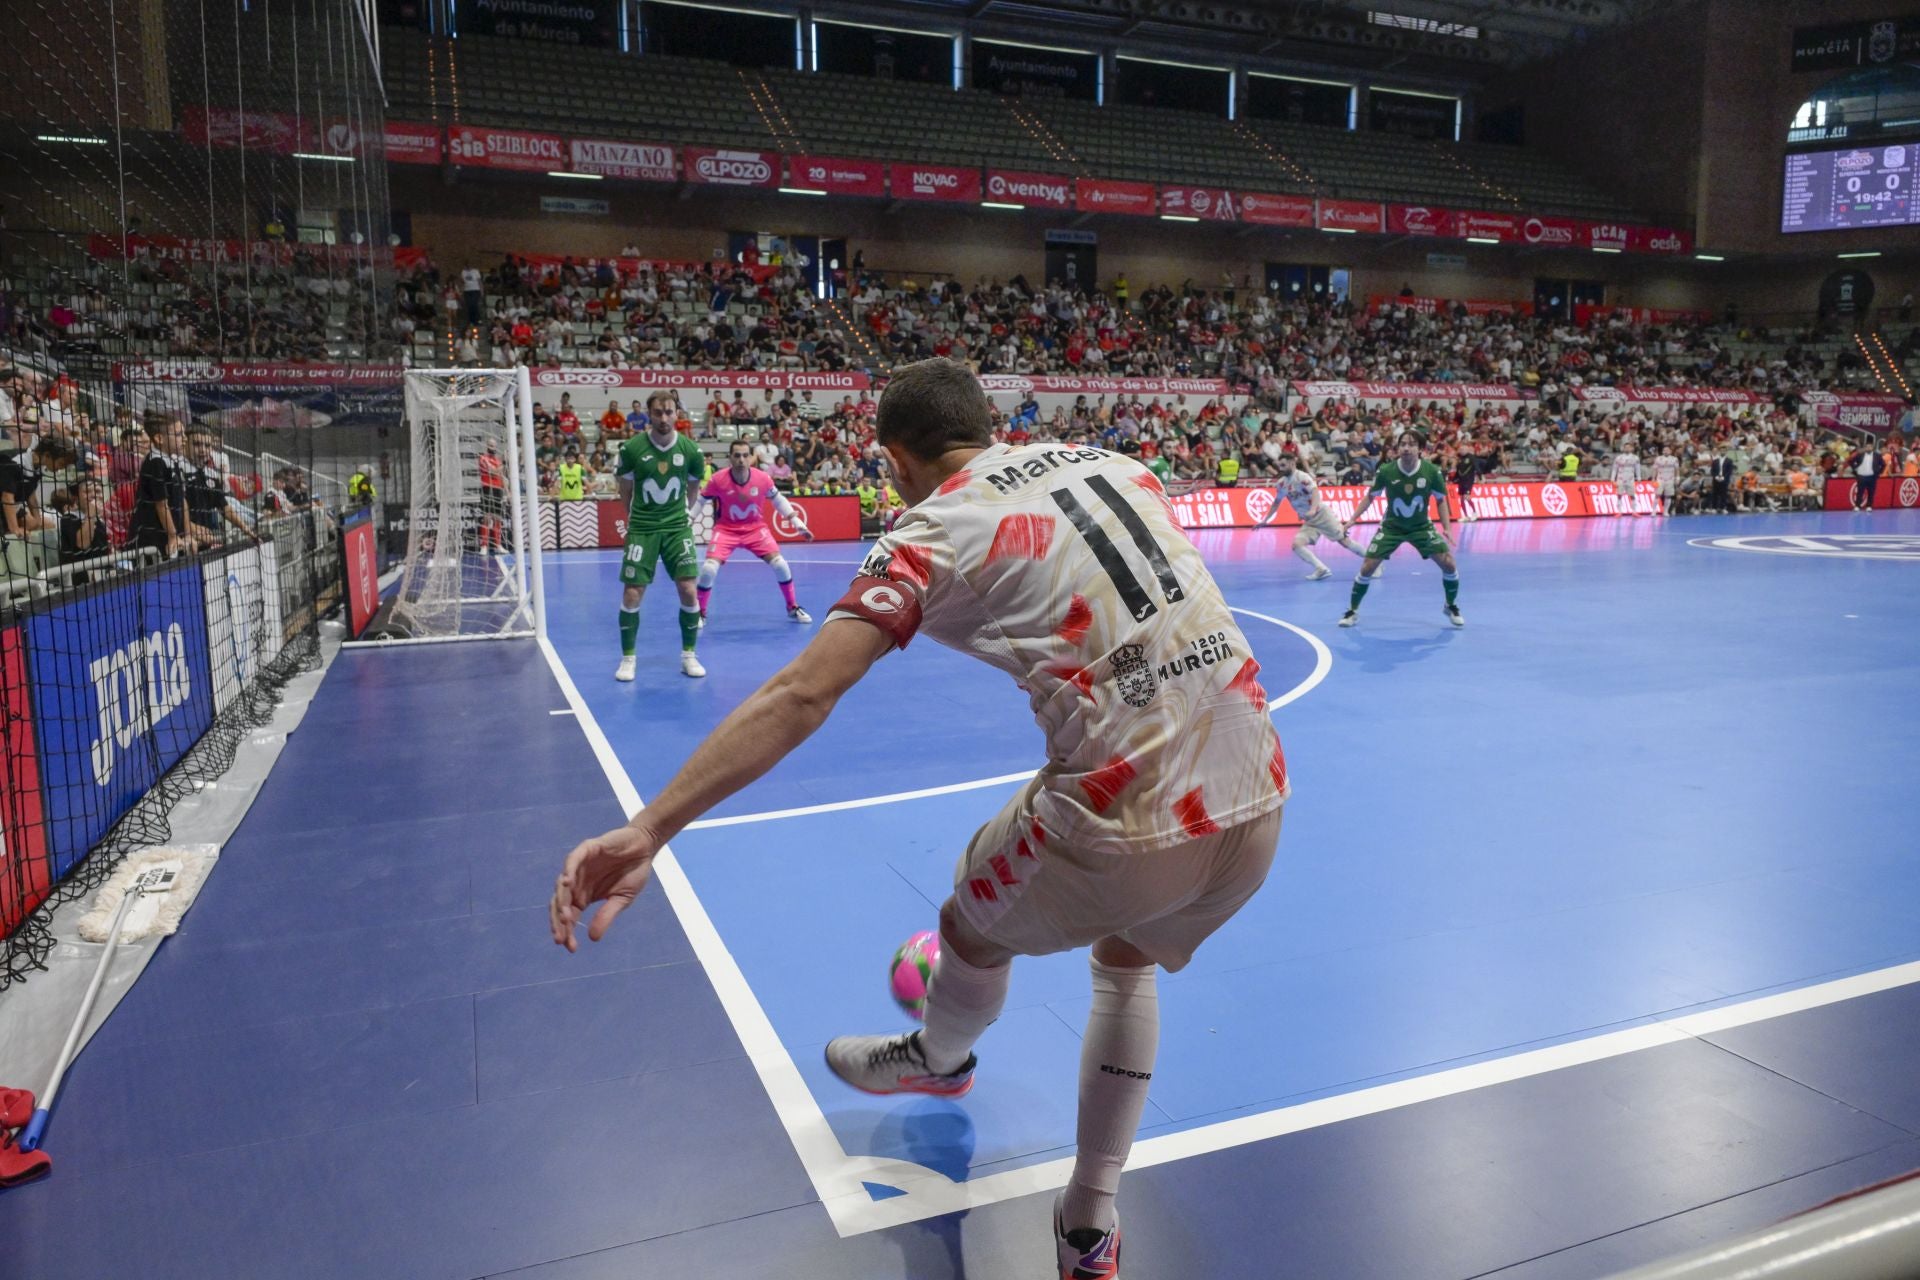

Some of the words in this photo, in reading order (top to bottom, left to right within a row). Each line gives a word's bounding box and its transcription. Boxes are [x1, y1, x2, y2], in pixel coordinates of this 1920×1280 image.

[487, 134, 561, 158] SEIBLOCK
[580, 142, 666, 167] MANZANO
[913, 172, 958, 187] NOVAC
[1847, 176, 1861, 192] 0
[1886, 174, 1900, 190] 0
[1854, 191, 1892, 203] 19:42
[640, 371, 685, 384] Uno
[691, 372, 731, 385] más
[737, 374, 760, 385] de
[765, 374, 782, 385] la
[787, 372, 854, 387] familia
[978, 378, 1031, 389] LPOZO
[1046, 376, 1082, 389] Uno
[1087, 377, 1118, 389] más
[1122, 379, 1140, 389] de
[1144, 379, 1159, 389] la
[1162, 378, 1216, 392] familia
[1367, 383, 1397, 394] Uno
[1401, 385, 1428, 394] más
[1431, 386, 1446, 395] de
[1447, 386, 1460, 395] la
[1462, 384, 1507, 397] familia
[1632, 388, 1659, 399] Uno
[985, 446, 1110, 495] Marcel
[1168, 489, 1229, 502] ISIÓN
[1471, 484, 1528, 497] VISIÓN
[1198, 503, 1235, 526] SALA
[1502, 495, 1533, 517] SALA
[626, 543, 644, 562] 10
[1050, 474, 1185, 623] 11
[861, 585, 905, 614] C
[1190, 631, 1225, 651] 1200
[1157, 642, 1233, 683] MURCIA
[1100, 1064, 1152, 1080] ELPOZO
